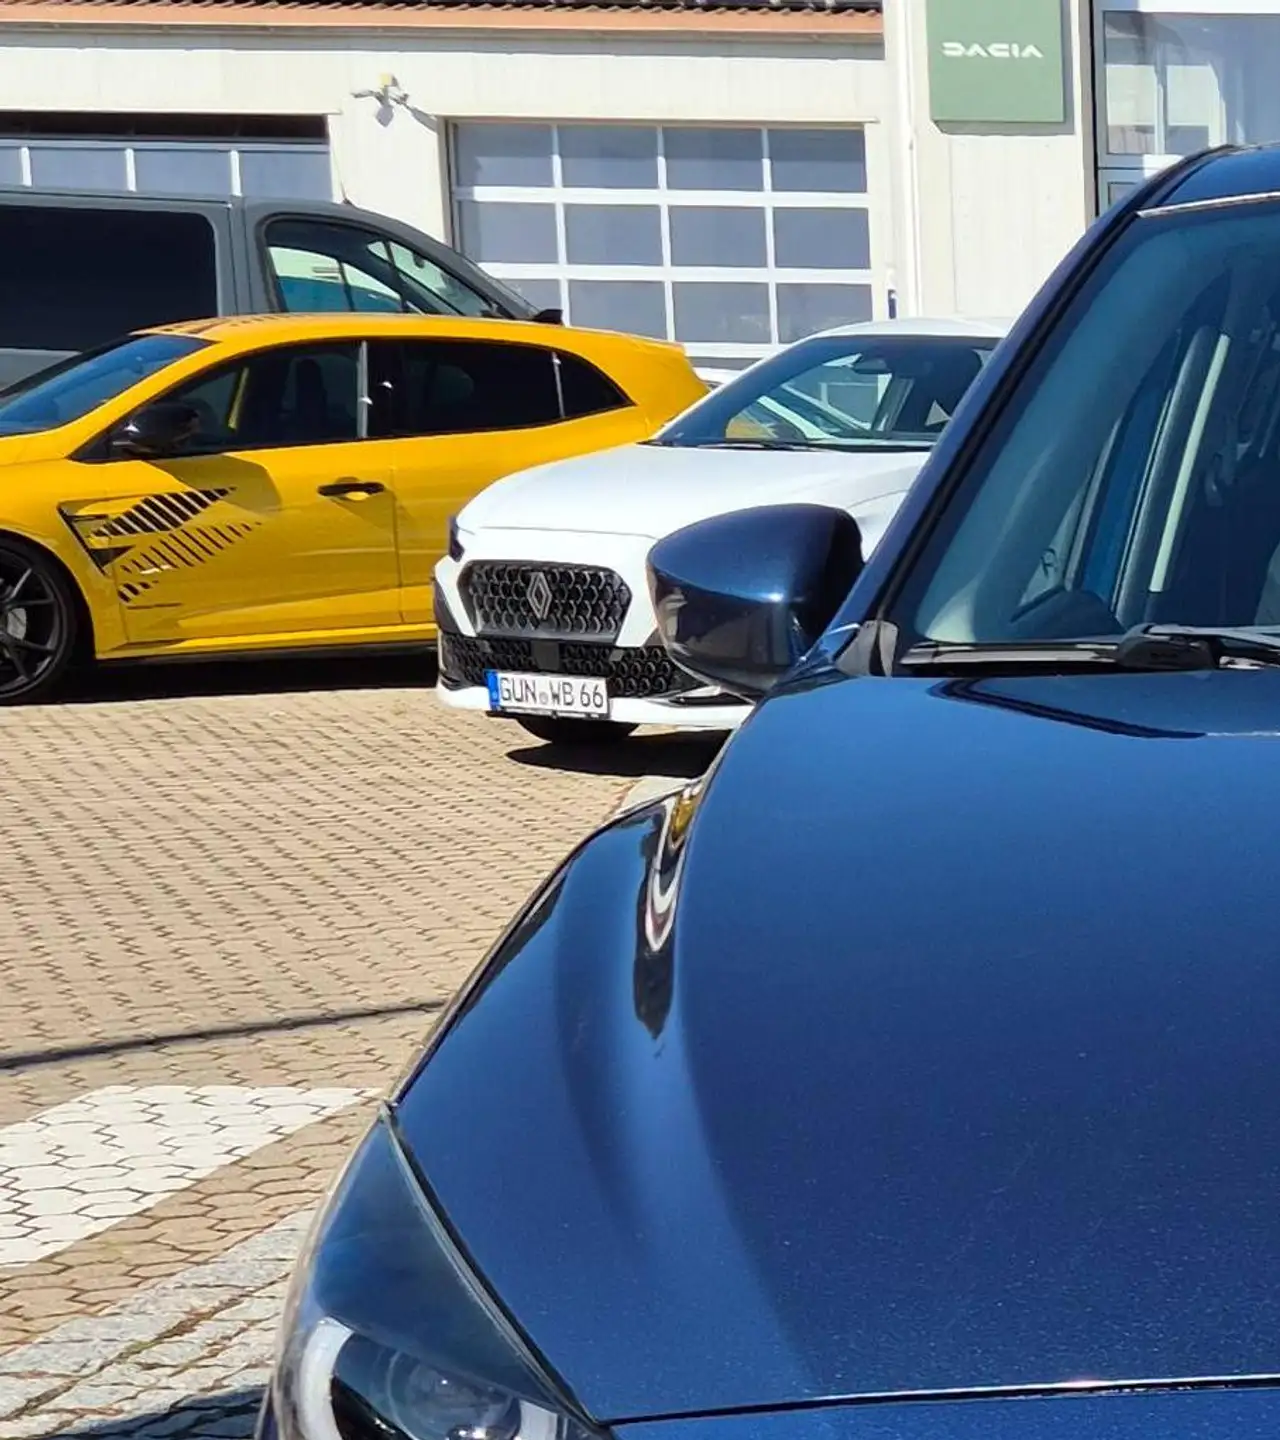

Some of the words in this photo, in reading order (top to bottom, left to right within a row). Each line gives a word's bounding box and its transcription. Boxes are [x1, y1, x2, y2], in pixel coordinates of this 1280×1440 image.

[941, 41, 1044, 59] DACIA
[500, 677, 537, 703] GUN
[549, 680, 575, 706] WB
[580, 682, 604, 708] 66
